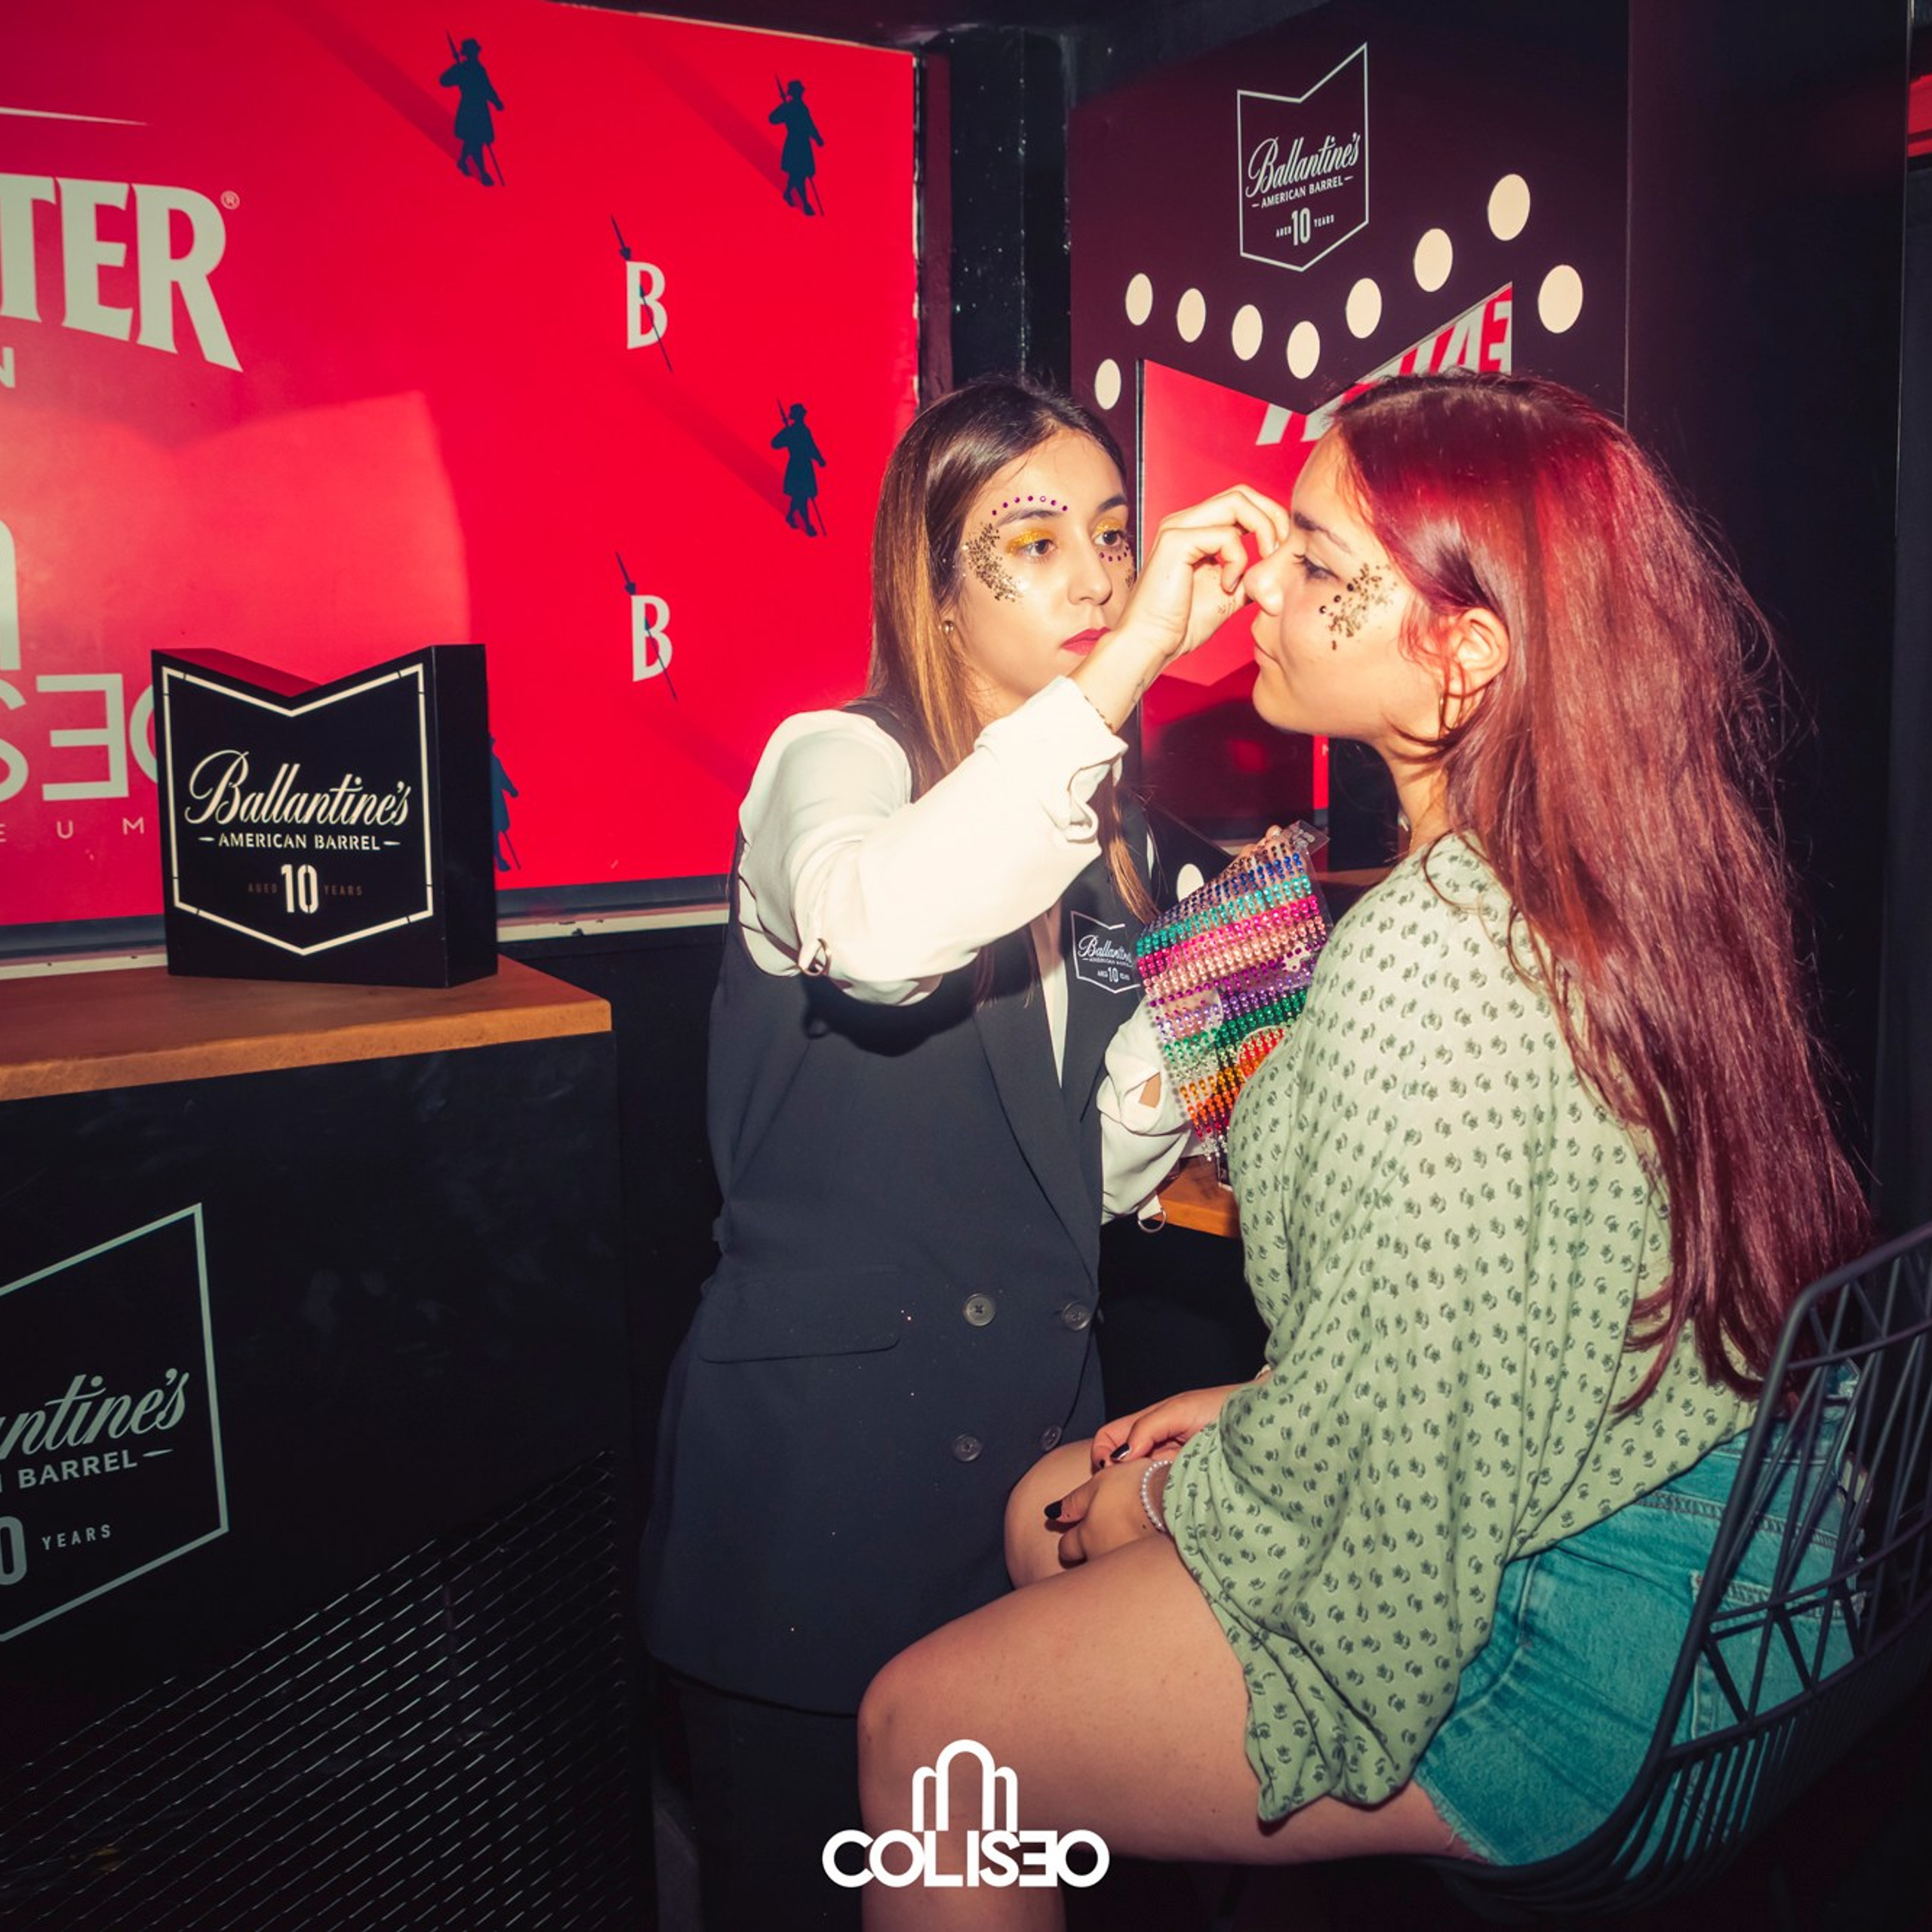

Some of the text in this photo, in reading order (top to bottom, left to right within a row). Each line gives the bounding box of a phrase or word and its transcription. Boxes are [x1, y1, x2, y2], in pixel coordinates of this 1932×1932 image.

[1245, 131, 1361, 198] Ballantine's
[1261, 175, 1343, 209] AMERICAN BARREL
[1291, 207, 1312, 246] 10
[1313, 214, 1335, 228] YEARS
[626, 260, 668, 349] B
[631, 594, 673, 682] B
[184, 749, 411, 826] Ballantine's
[218, 832, 381, 851] AMERICAN BARREL
[281, 863, 319, 914] 10
[324, 884, 364, 897] YEARS
[1108, 967, 1119, 983] 10
[0, 1367, 189, 1460] ntine's
[18, 1449, 138, 1489] BARREL
[42, 1524, 111, 1551] YEARS
